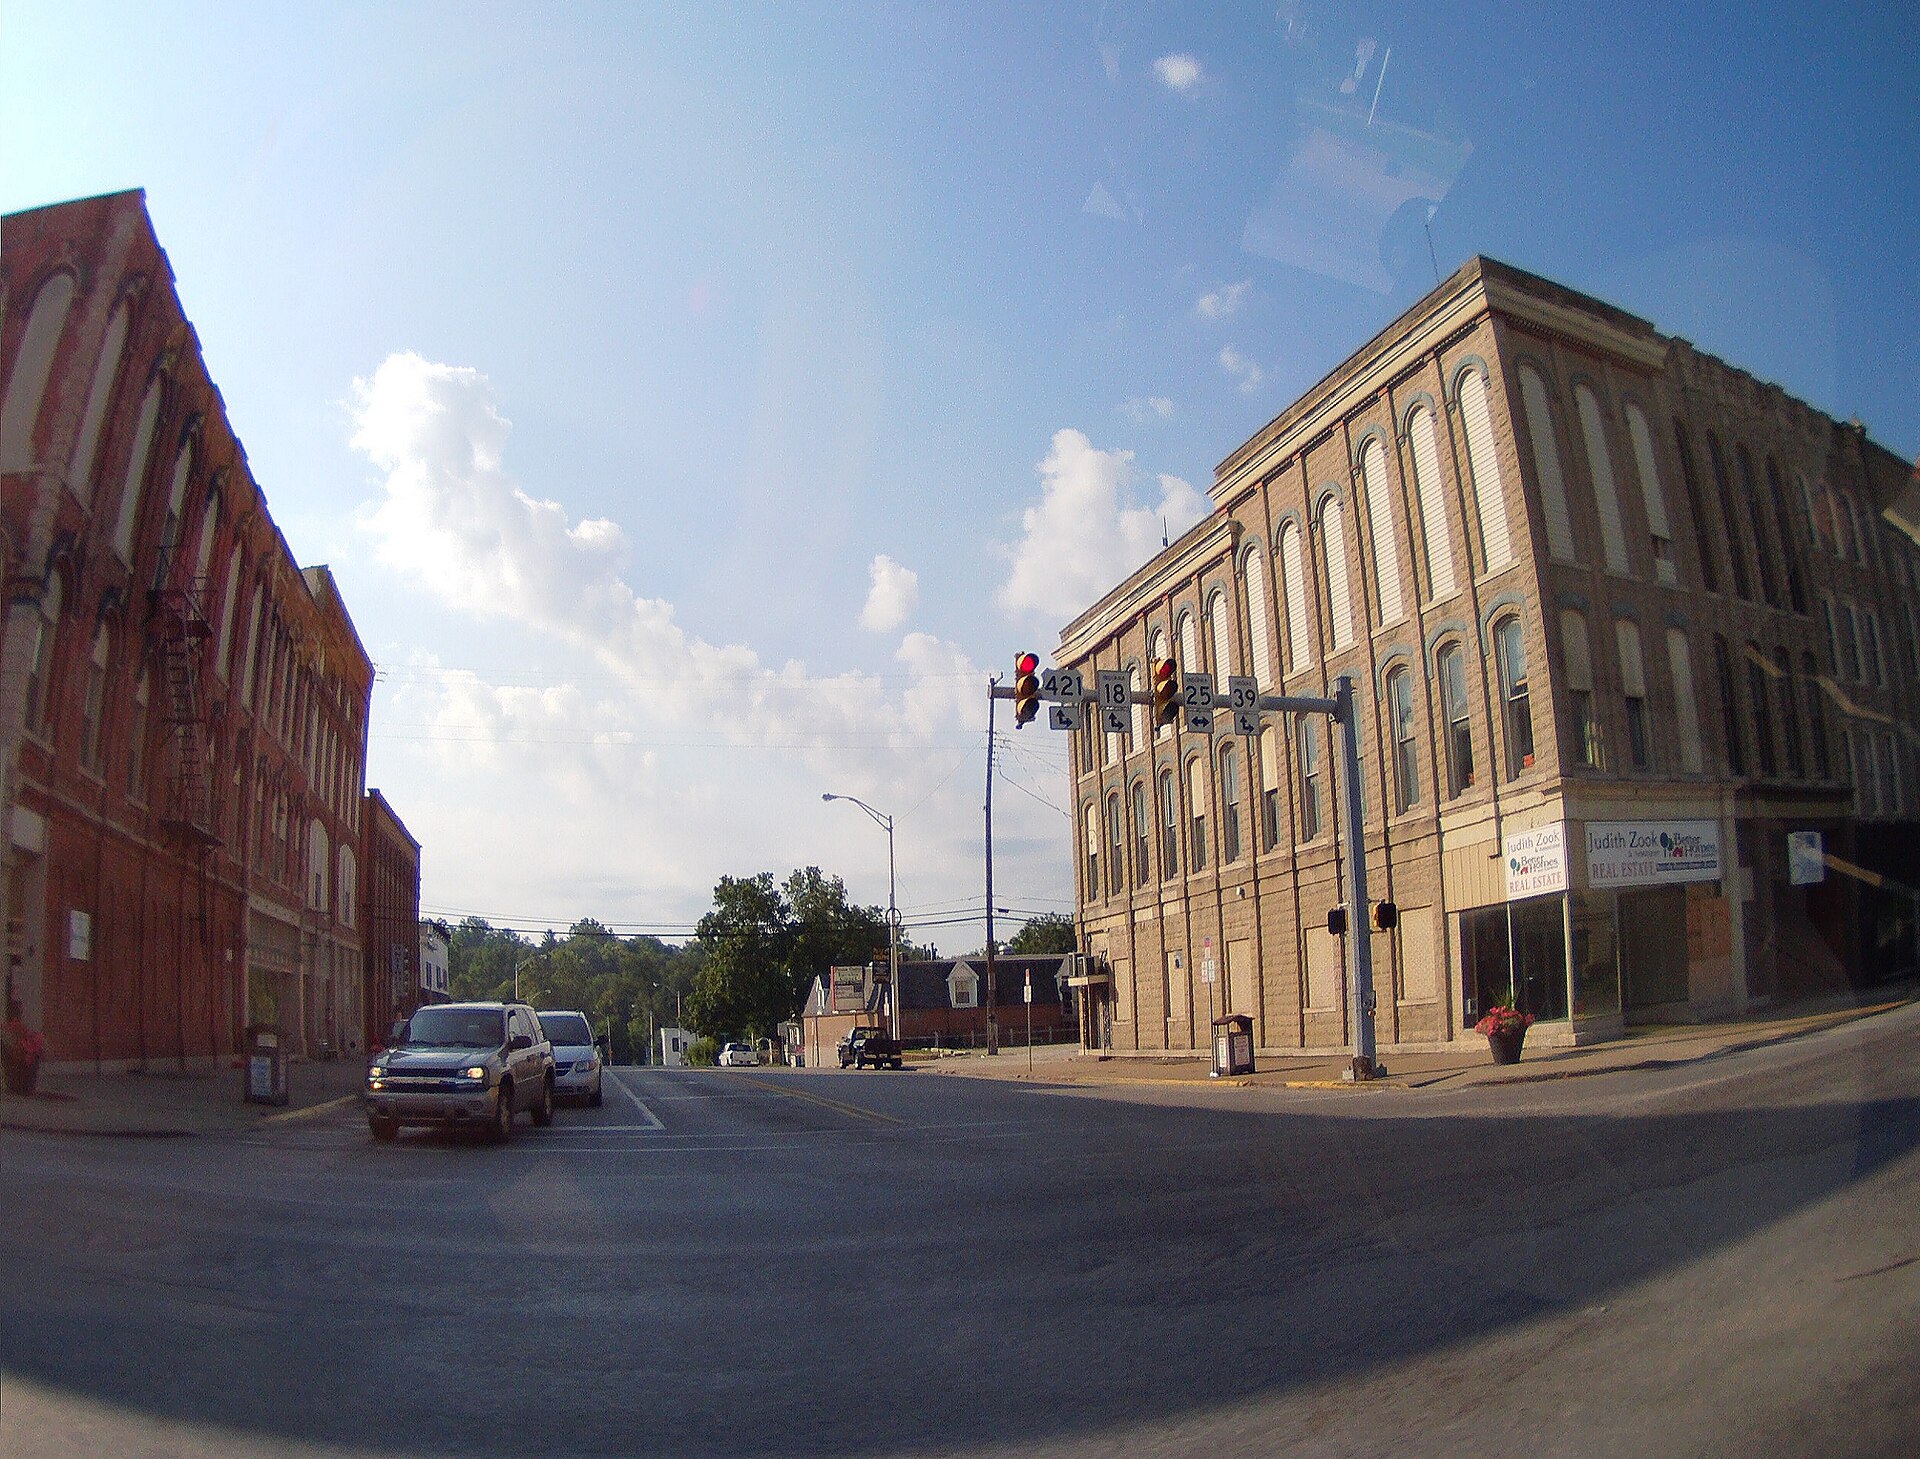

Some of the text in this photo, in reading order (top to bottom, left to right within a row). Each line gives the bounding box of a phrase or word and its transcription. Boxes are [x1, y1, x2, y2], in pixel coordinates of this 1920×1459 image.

[1045, 675, 1082, 696] 421
[1104, 684, 1125, 704] 18
[1186, 685, 1211, 705] 25
[1233, 688, 1256, 708] 39
[1507, 836, 1534, 855] Judith
[1536, 831, 1560, 846] Zook
[1589, 830, 1657, 853] Judith Zook
[1592, 862, 1619, 879] REAL
[1621, 861, 1658, 878] ESTATE
[1509, 871, 1563, 894] REAL ESTATE
